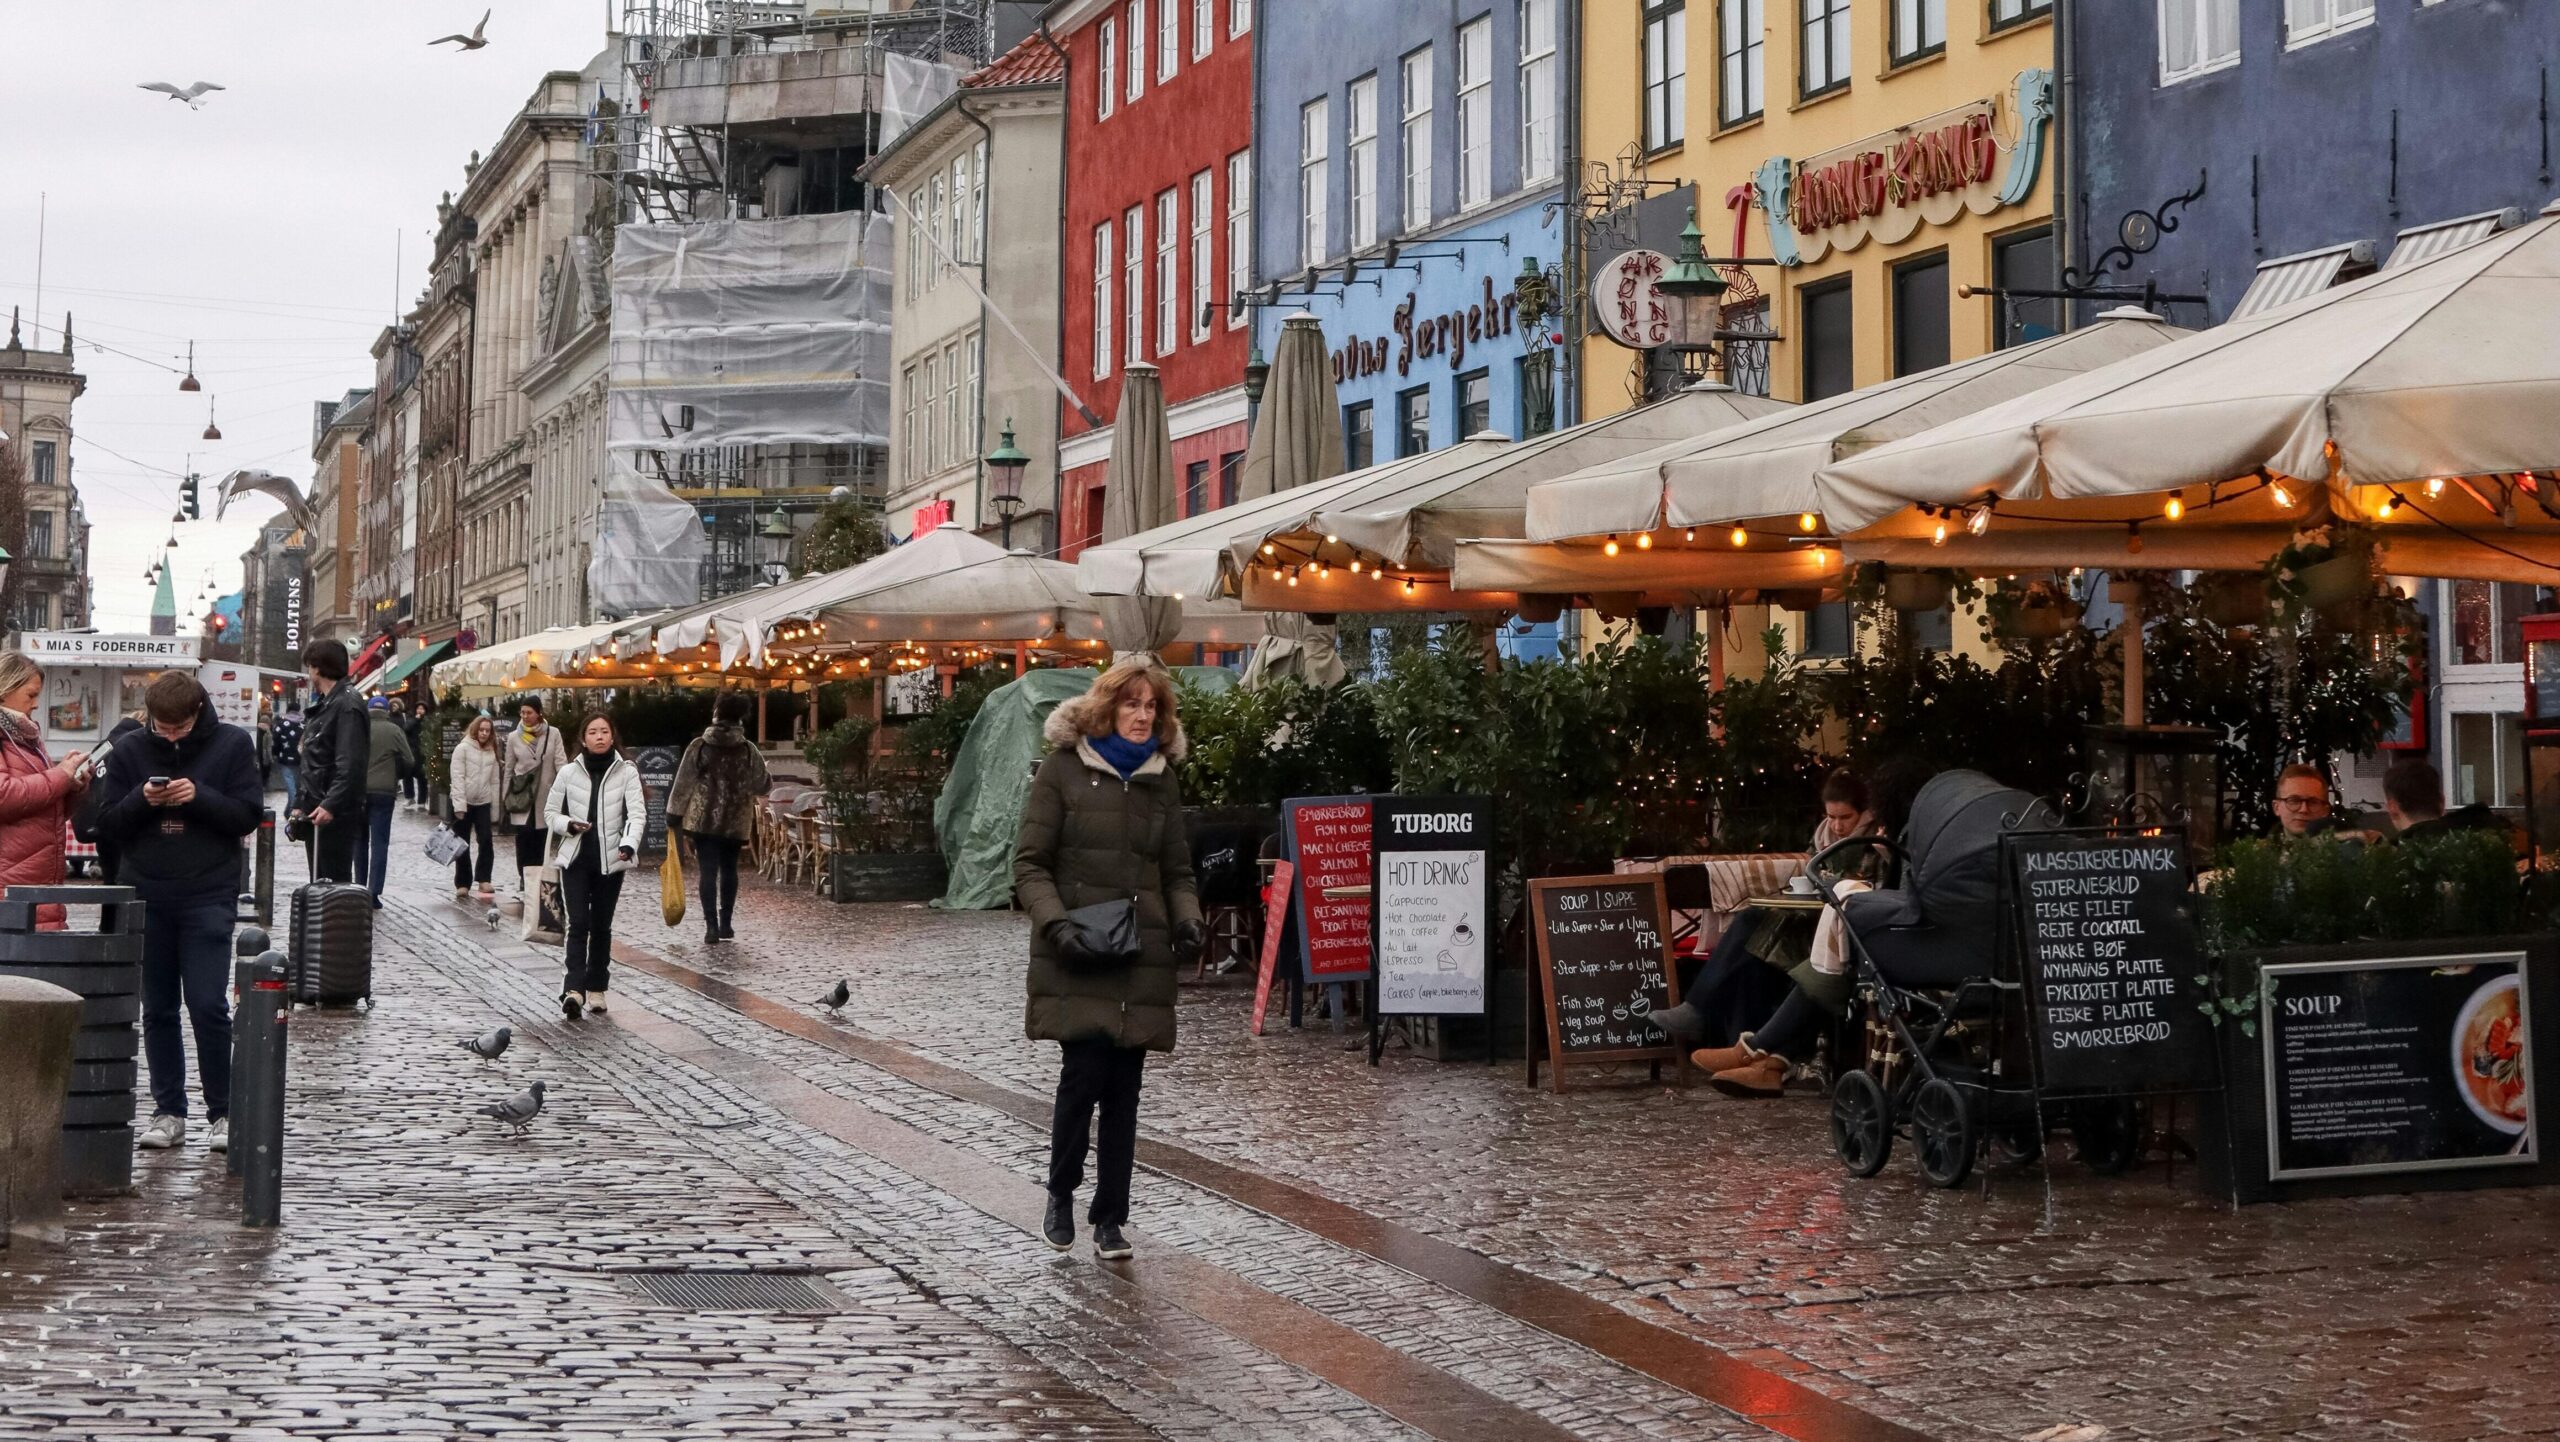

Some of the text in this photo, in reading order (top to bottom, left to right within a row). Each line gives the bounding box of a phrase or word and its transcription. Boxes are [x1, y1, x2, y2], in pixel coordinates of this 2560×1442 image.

[1789, 114, 1996, 235] HONG KONG
[286, 578, 301, 650] BOLTENS
[93, 641, 175, 654] FODERBRÆT
[1391, 813, 1473, 834] TUBORG
[1302, 843, 1324, 855] MAC
[1336, 840, 1371, 853] CHEESE
[1320, 857, 1358, 870] SALMON
[2026, 848, 2176, 872] KLASSIKERE DANSK
[1389, 861, 1470, 887] HOT DRINKS
[2031, 876, 2140, 897] STJERNESKUD
[1389, 894, 1438, 907] Cappuccino
[1560, 894, 1589, 910] SOUP
[1604, 891, 1637, 908] SUPPE
[2035, 900, 2133, 918] FISKE FILET
[1388, 913, 1402, 923] Hot
[1552, 920, 1570, 934] Lille
[2038, 919, 2145, 938] REJE COCKTAIL
[1387, 941, 1398, 952] Au
[2040, 941, 2127, 960] HAKKE BØF
[1389, 971, 1405, 981] Tea
[1580, 960, 1601, 977] Suppe
[2043, 958, 2165, 979] NYHAVNS PLATTE
[2046, 978, 2175, 1002] FYRTØJET PLATTE
[1561, 995, 1581, 1010] Fish
[2285, 995, 2342, 1016] SOUP
[2048, 1001, 2156, 1024] FISKE PLATTE
[1592, 1032, 1602, 1044] of
[1607, 1029, 1622, 1044] the
[1626, 1030, 1642, 1047] day
[2053, 1021, 2170, 1048] SMØRREBRØD
